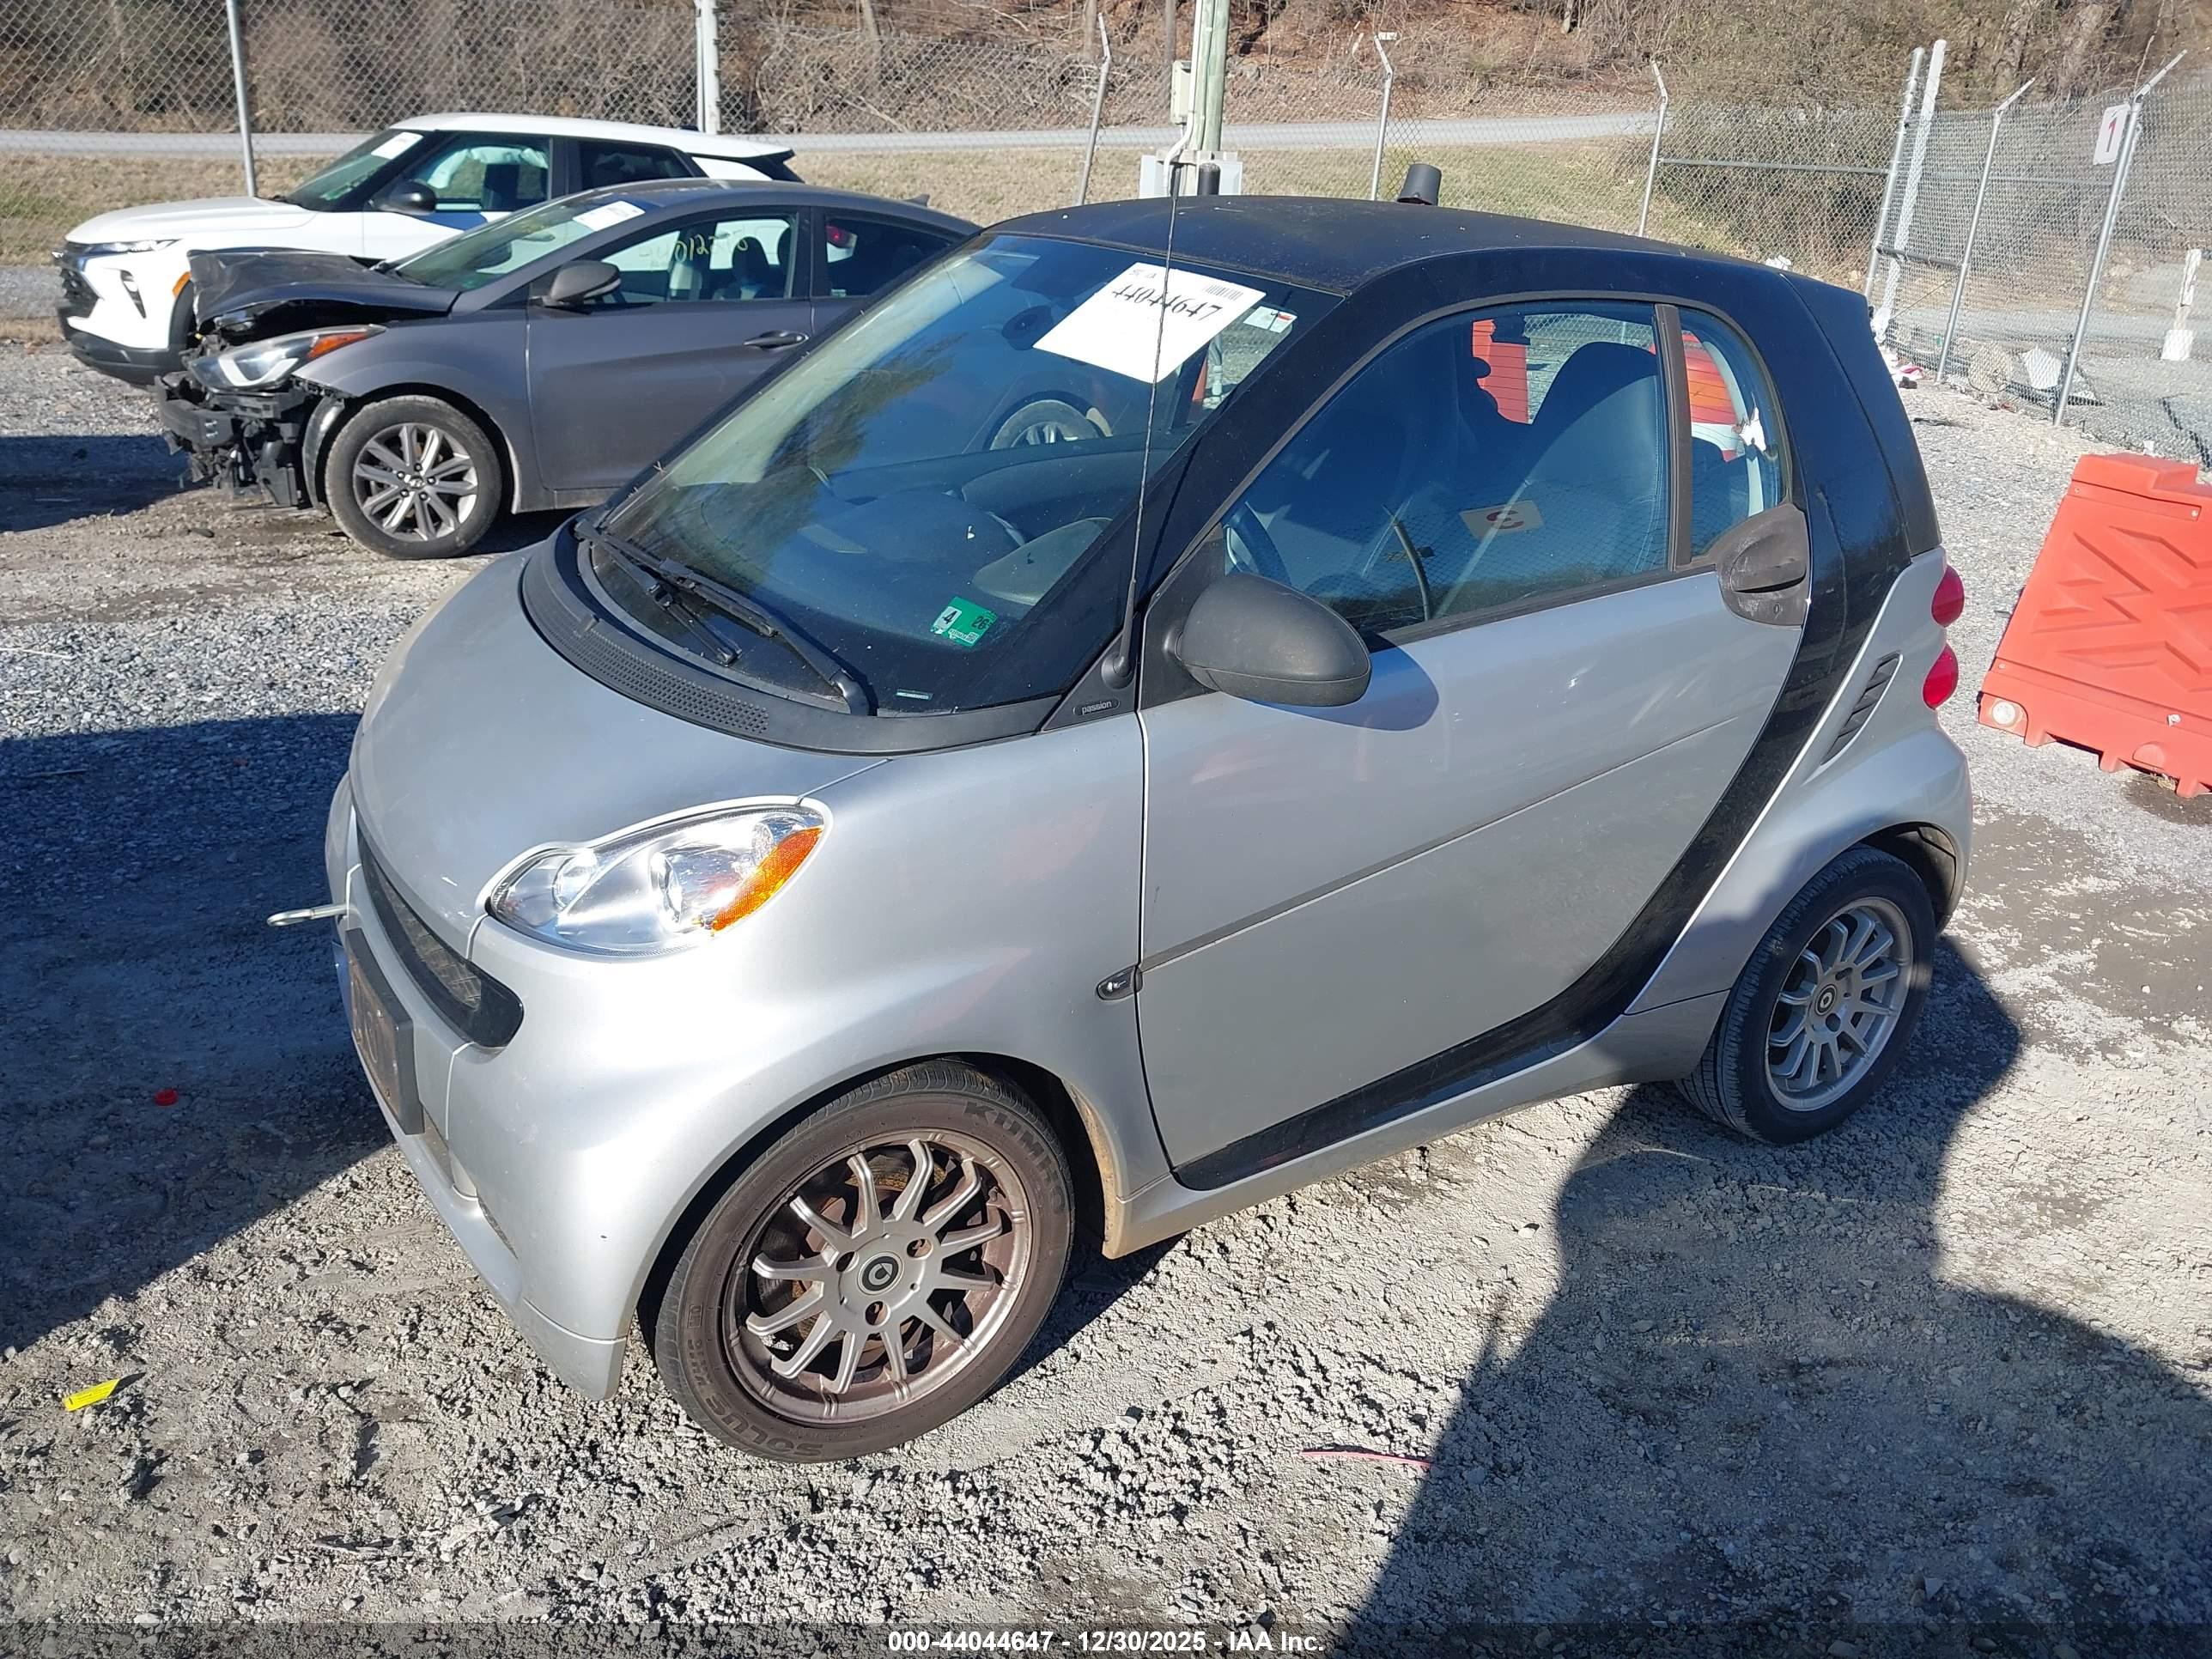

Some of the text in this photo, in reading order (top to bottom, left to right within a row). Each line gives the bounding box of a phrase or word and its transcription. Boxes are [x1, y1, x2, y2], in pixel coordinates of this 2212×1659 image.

[2106, 113, 2118, 153] 1
[1112, 284, 1224, 321] 44044647
[943, 611, 958, 625] 4
[971, 616, 990, 630] 26
[1082, 701, 1113, 715] passion
[963, 1101, 1068, 1212] KUMHO
[705, 1392, 824, 1457] SOLUS
